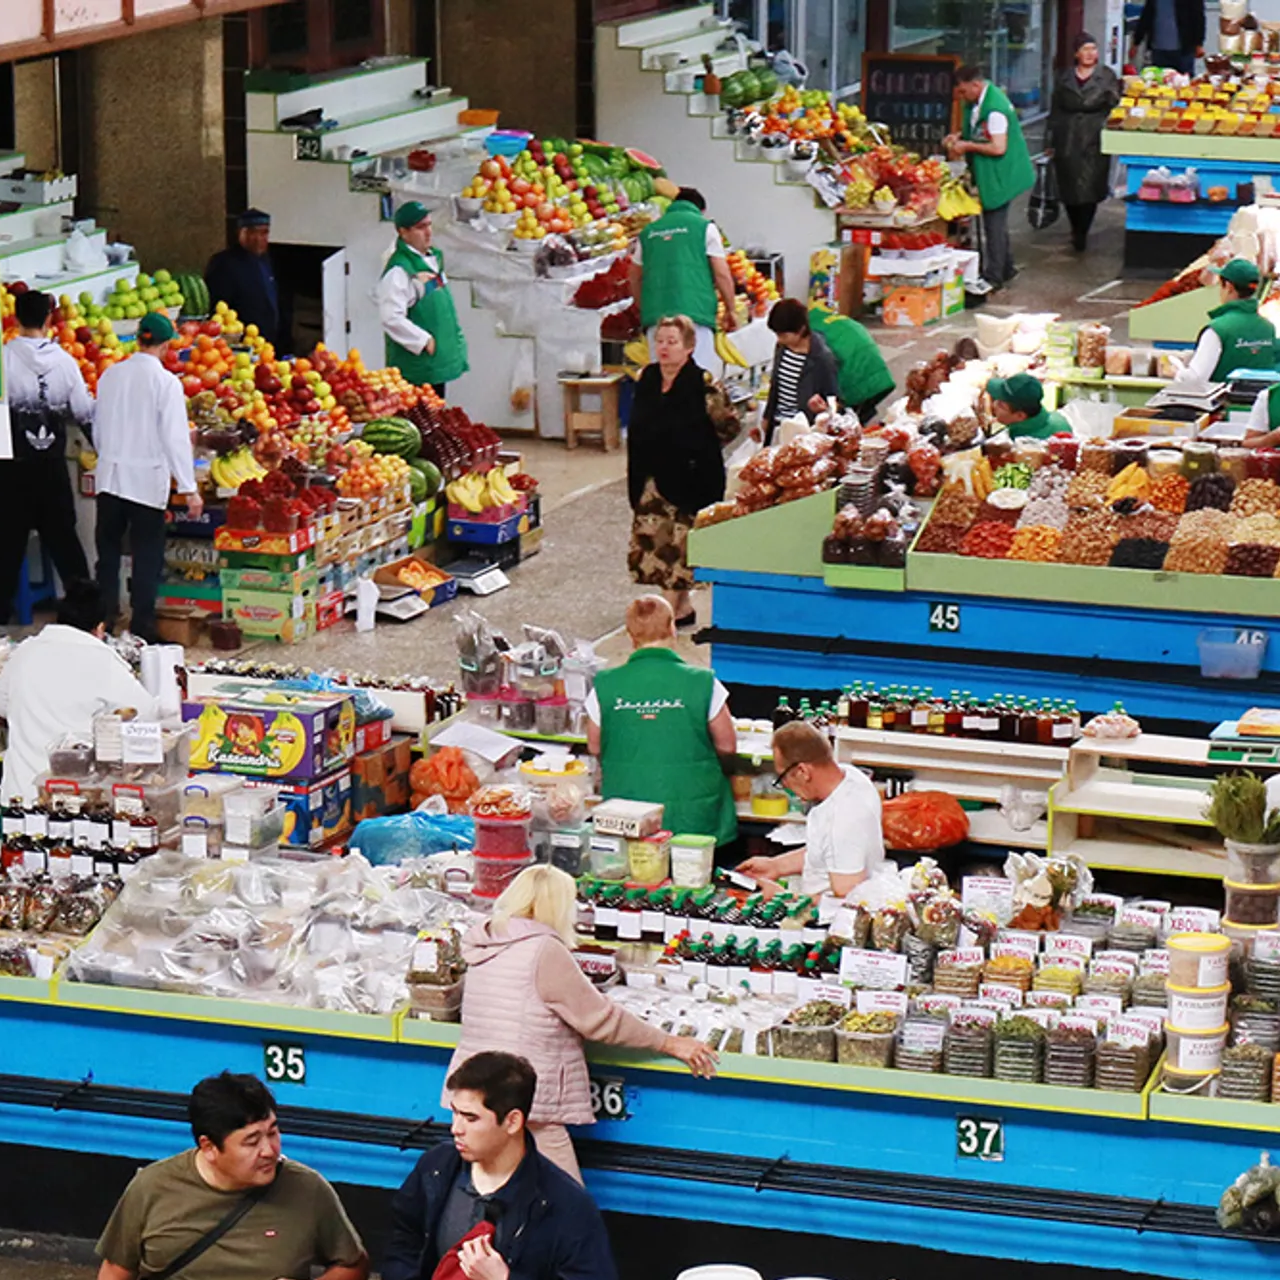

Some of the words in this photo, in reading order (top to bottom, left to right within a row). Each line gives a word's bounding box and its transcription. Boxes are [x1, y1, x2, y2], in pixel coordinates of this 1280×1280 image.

[930, 604, 960, 631] 45
[266, 1046, 305, 1080] 35
[959, 1119, 1000, 1154] 37
